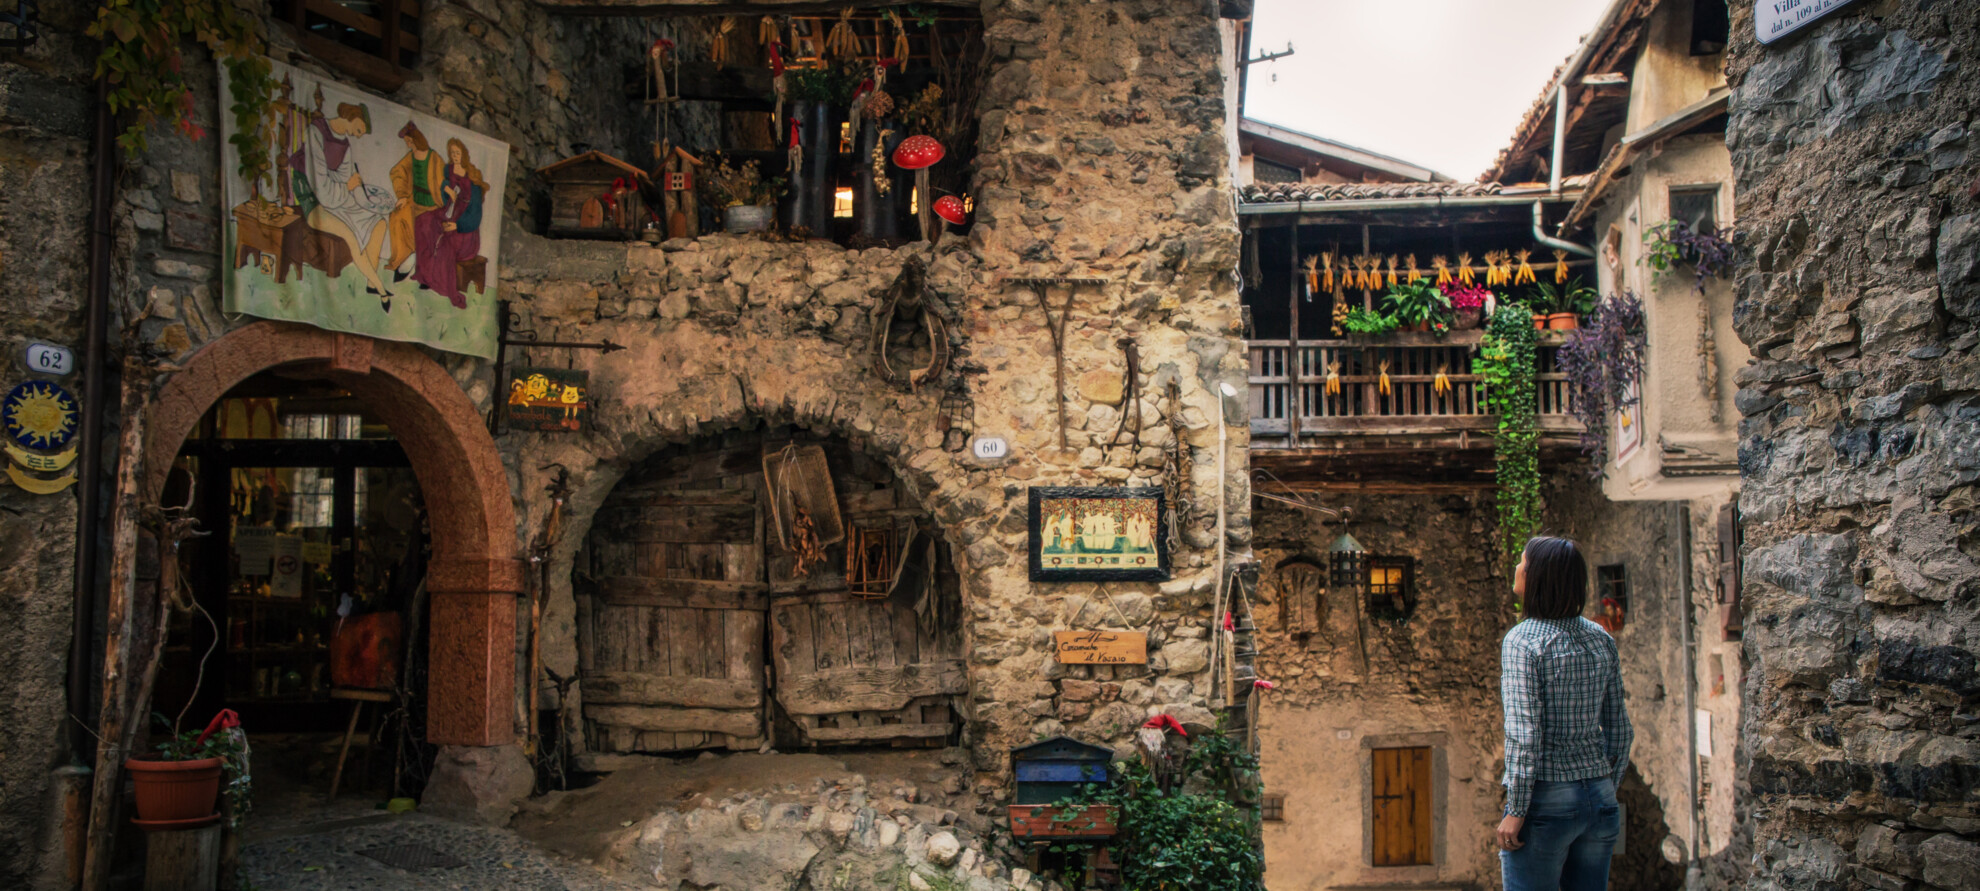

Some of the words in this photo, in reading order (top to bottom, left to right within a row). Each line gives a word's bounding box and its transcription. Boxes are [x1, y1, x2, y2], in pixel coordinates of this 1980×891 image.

[1774, 0, 1801, 15] Villa
[1771, 19, 1783, 33] dal
[1784, 19, 1793, 27] n.
[1796, 5, 1812, 21] 109
[1814, 0, 1822, 13] al
[1823, 0, 1832, 8] n.
[40, 350, 62, 369] 62
[983, 441, 998, 454] 60
